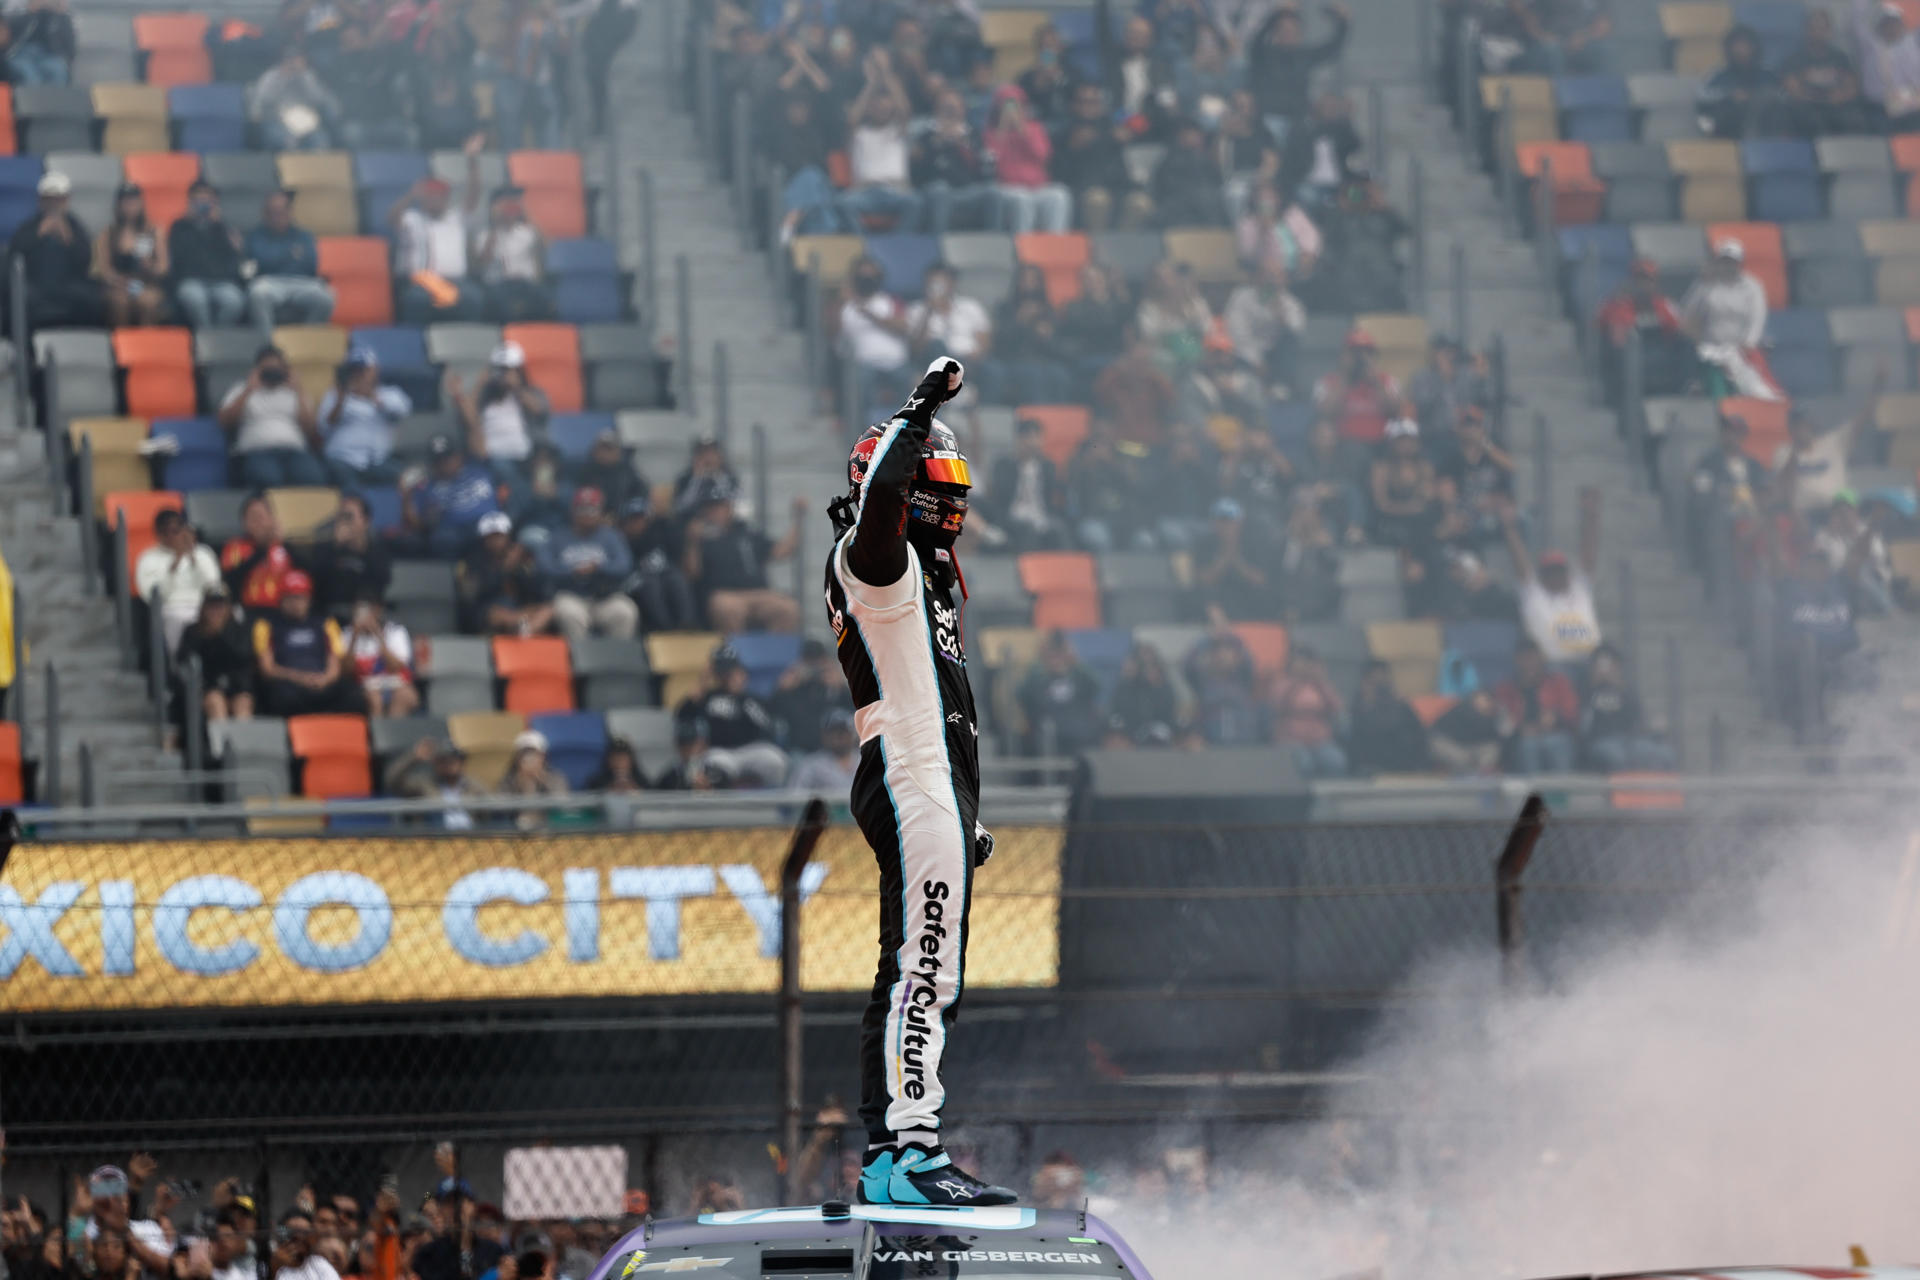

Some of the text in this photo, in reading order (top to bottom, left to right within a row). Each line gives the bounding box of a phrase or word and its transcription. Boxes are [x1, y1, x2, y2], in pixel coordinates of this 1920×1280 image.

[851, 463, 864, 484] Re
[910, 497, 938, 510] Culture
[914, 490, 939, 504] Safety
[0, 862, 830, 979] XICO CITY
[903, 879, 949, 1100] SafetyCulture
[872, 1251, 1102, 1264] VAN GISBERGEN
